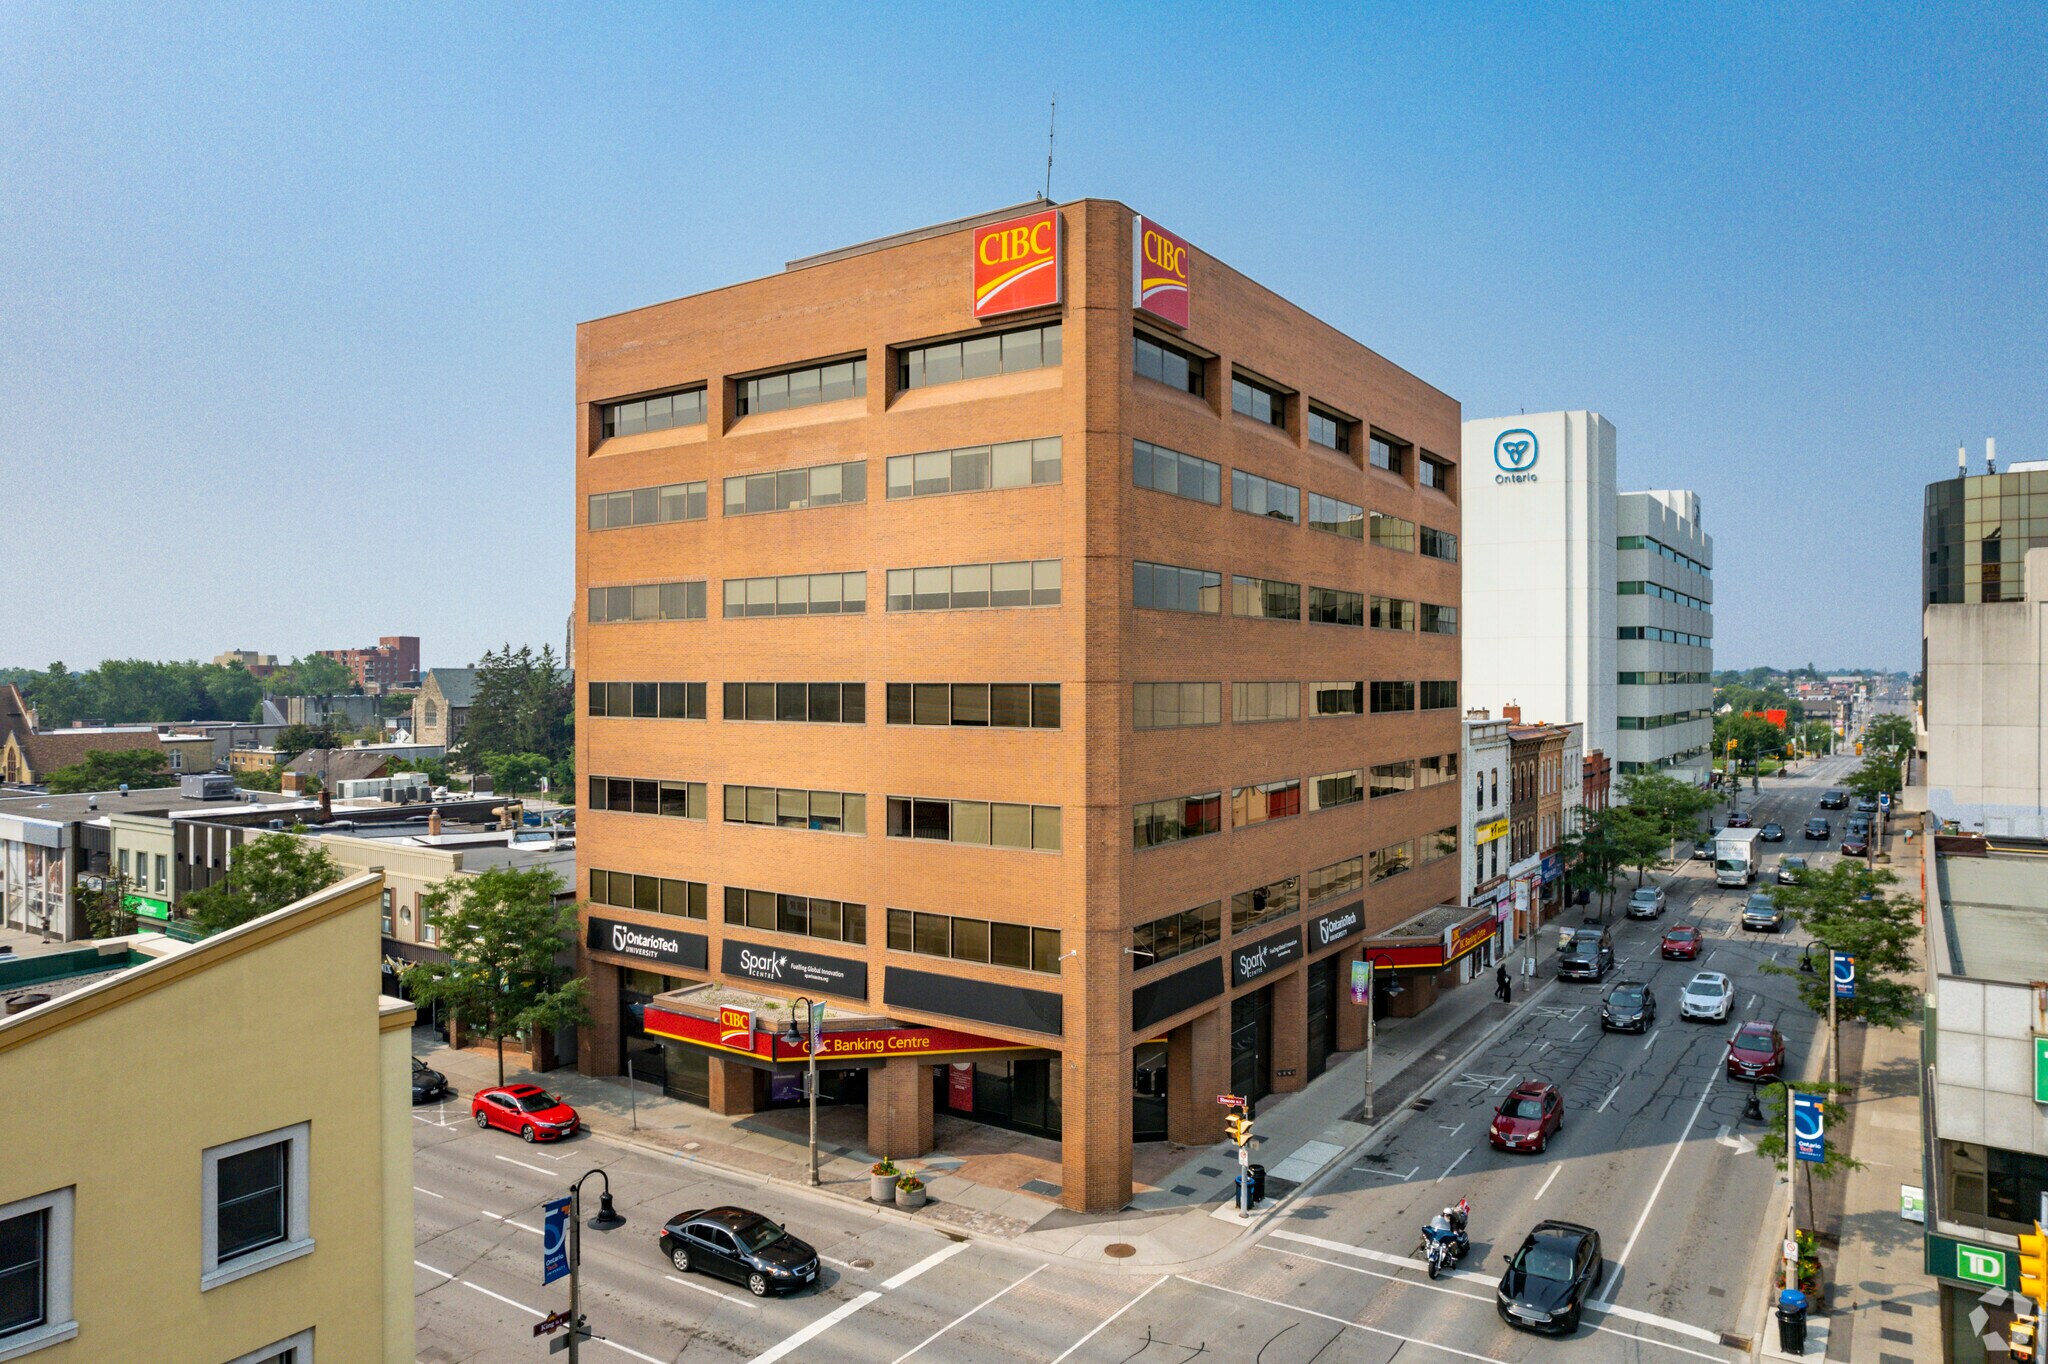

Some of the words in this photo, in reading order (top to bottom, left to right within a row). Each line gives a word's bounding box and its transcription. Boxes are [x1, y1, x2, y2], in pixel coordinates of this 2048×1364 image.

[979, 220, 1051, 266] CIBC
[1143, 229, 1187, 279] CIBC
[1494, 473, 1538, 485] Ontario
[625, 946, 659, 958] UNIVERSITY
[740, 949, 782, 978] Spark
[1240, 945, 1267, 978] Spark
[751, 970, 775, 980] CENTRE
[807, 965, 821, 974] Global
[821, 967, 845, 978] Innovation
[721, 1011, 749, 1030] CIBC
[834, 1037, 884, 1053] Banking
[887, 1036, 930, 1050] Centre
[1798, 1140, 1822, 1149] Ontario
[546, 1254, 564, 1266] Ontario
[1962, 1250, 2000, 1278] TD
[546, 1263, 558, 1271] Tech
[541, 1321, 555, 1331] King
